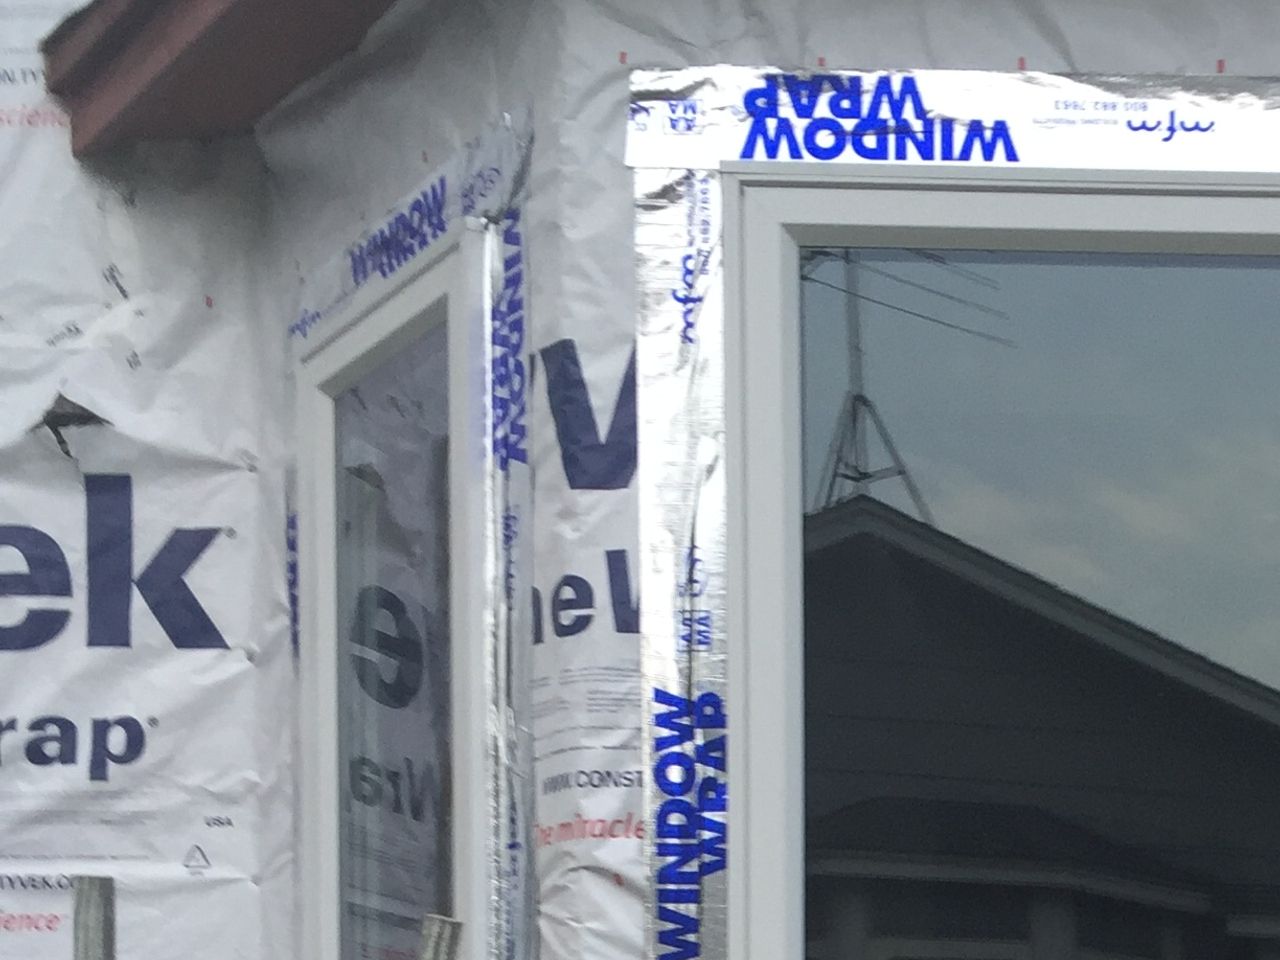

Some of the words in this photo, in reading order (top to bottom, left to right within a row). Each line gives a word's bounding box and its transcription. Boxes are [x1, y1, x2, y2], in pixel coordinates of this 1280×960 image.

[744, 74, 928, 120] WRAP
[741, 117, 1020, 162] WINDOW
[1127, 110, 1215, 142] mfm
[695, 690, 728, 878] WRAP
